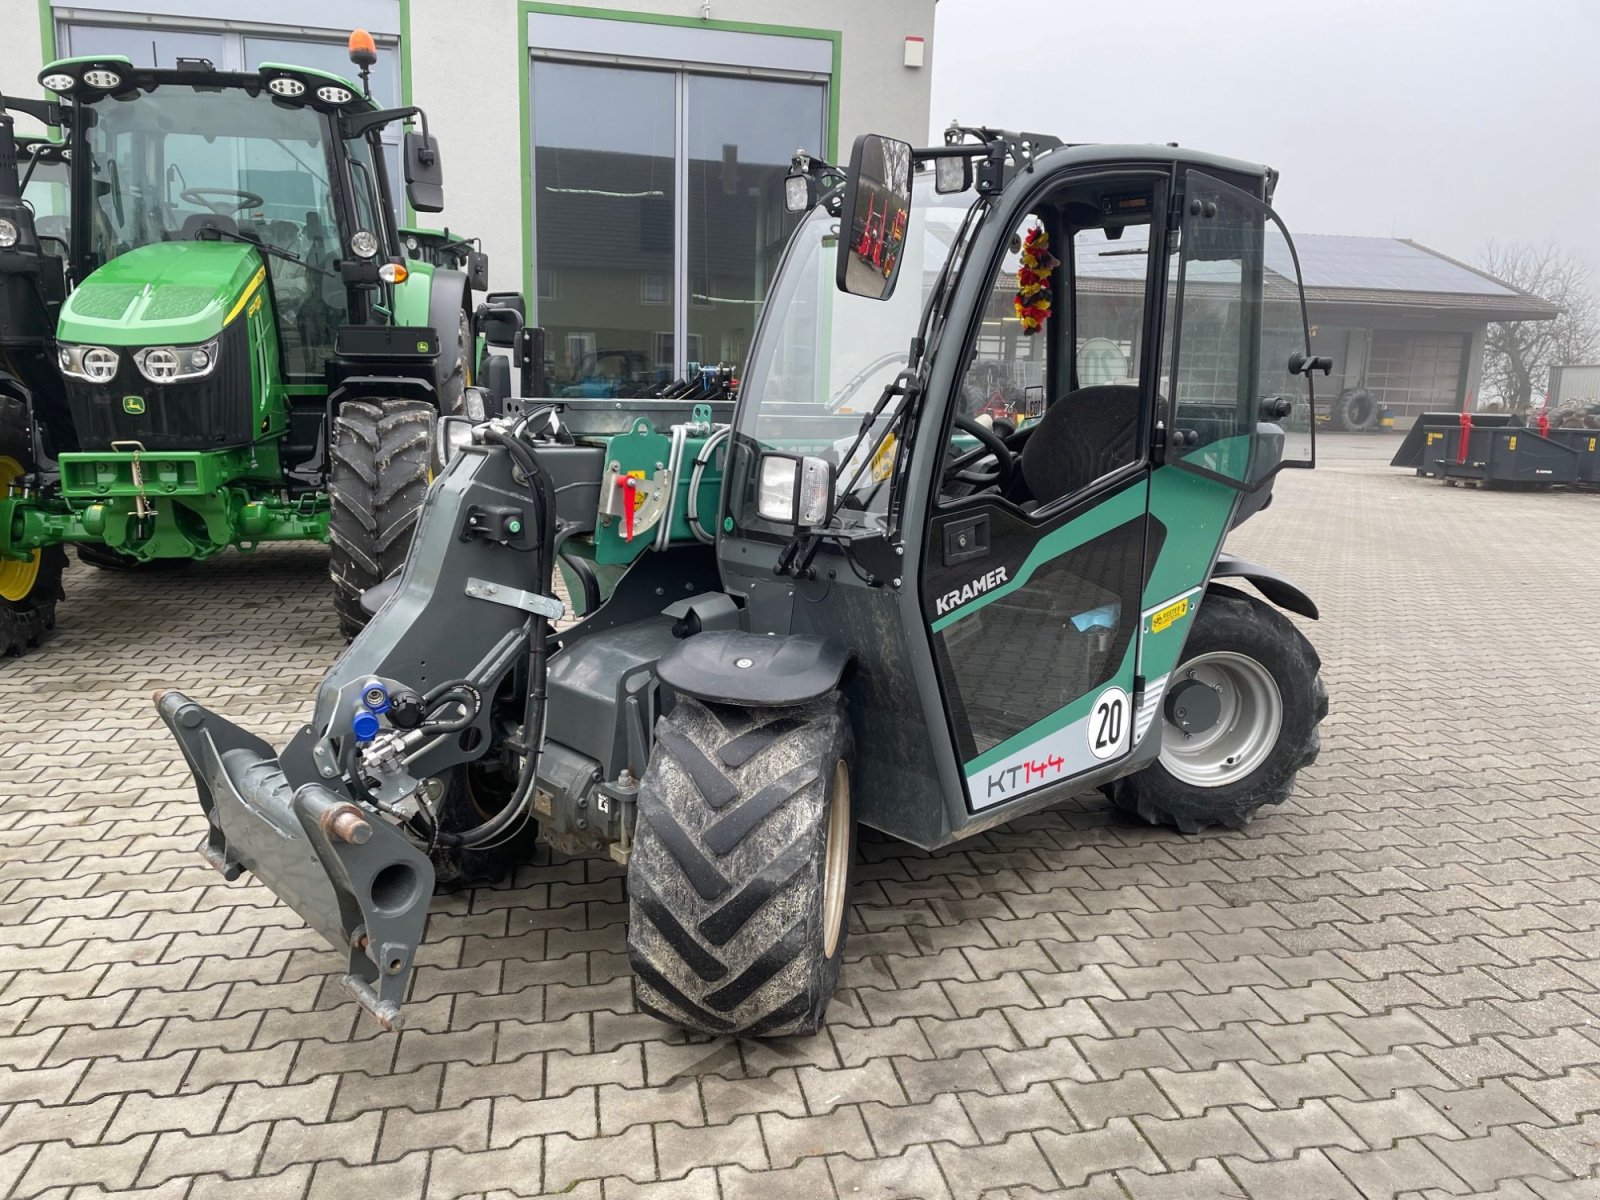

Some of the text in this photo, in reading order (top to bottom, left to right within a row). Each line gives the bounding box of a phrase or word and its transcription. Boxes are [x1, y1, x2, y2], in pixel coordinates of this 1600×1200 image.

[935, 566, 1008, 616] KRAMER
[1095, 699, 1122, 750] 20
[987, 754, 1064, 798] KT144
